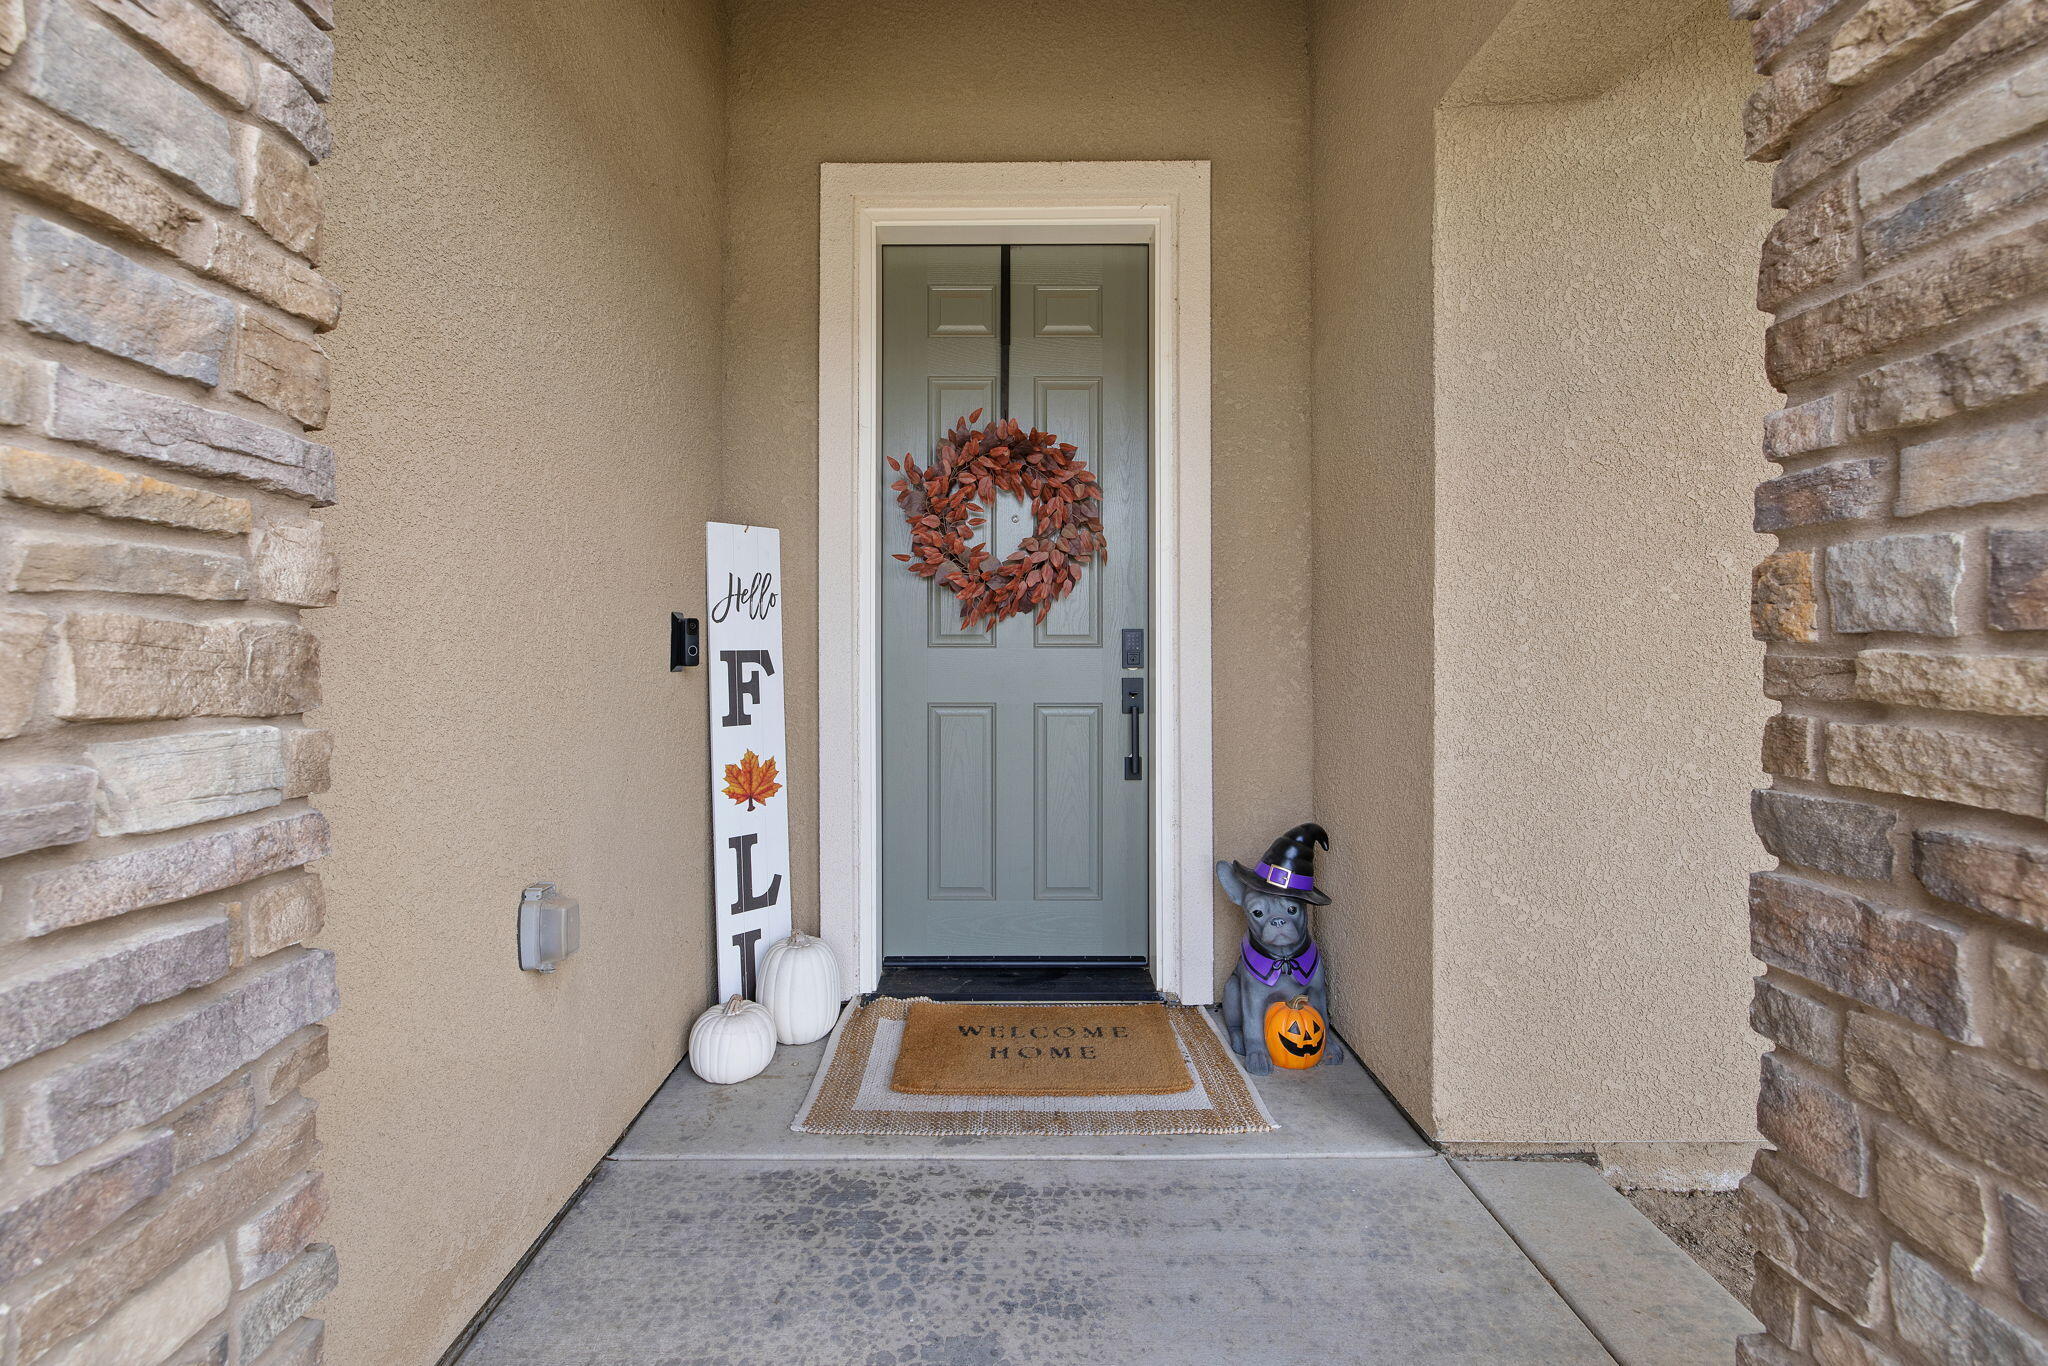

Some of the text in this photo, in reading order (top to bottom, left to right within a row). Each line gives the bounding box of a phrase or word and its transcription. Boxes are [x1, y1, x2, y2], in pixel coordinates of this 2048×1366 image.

[711, 572, 778, 623] Hello
[958, 1025, 1129, 1039] WELCOME
[989, 1046, 1097, 1060] HOME
